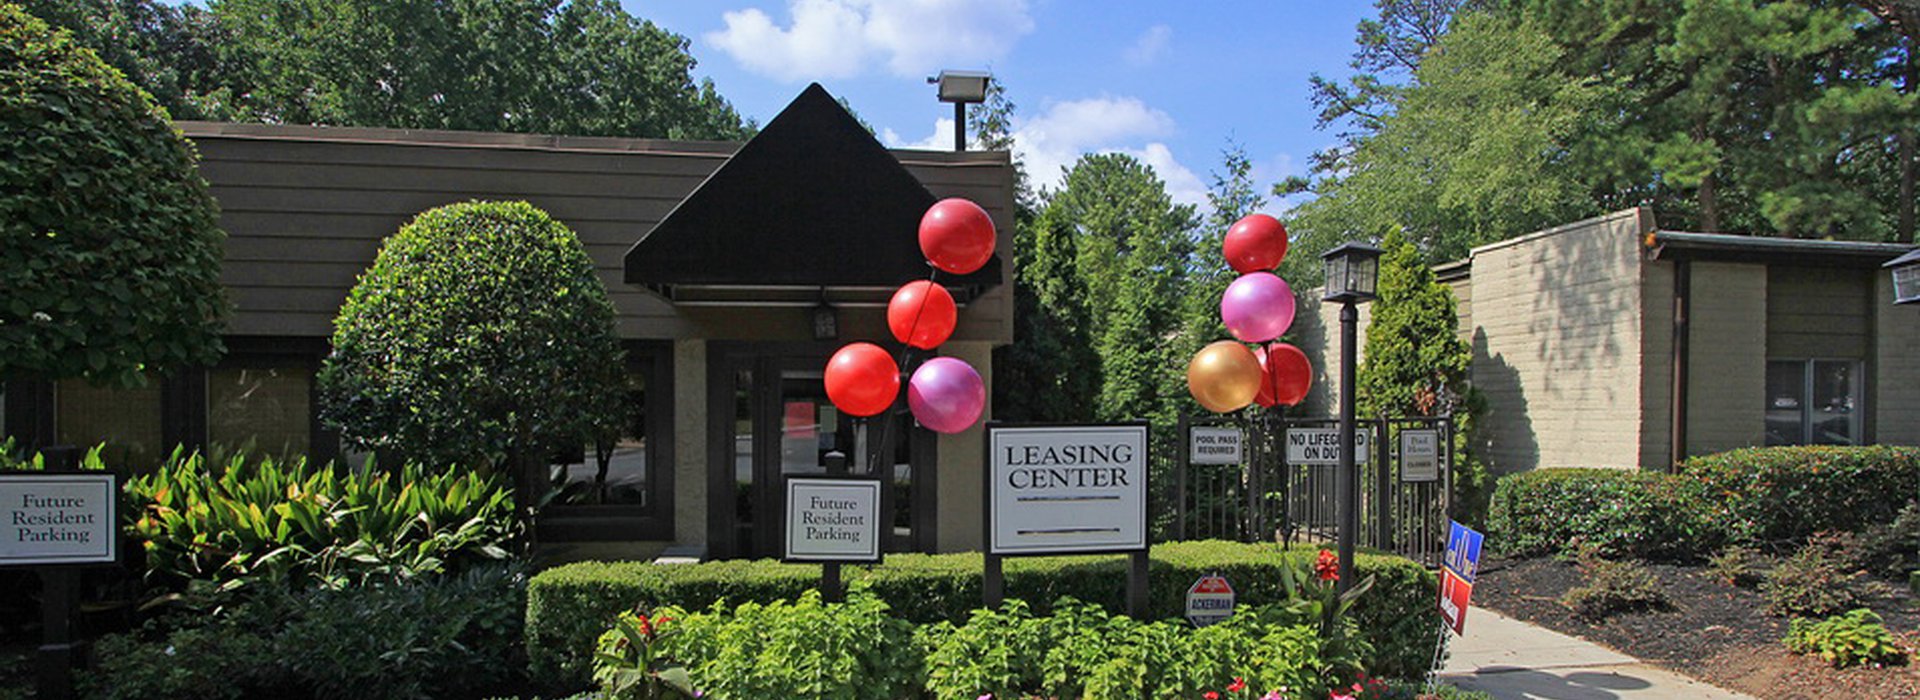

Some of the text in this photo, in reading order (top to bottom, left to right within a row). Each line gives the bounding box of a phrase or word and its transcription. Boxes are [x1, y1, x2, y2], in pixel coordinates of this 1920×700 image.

[1195, 435, 1238, 444] POOL PASS
[1290, 433, 1365, 446] NO LIFEGD
[1005, 444, 1132, 466] LEASING
[1197, 445, 1236, 455] REQUIRED
[1304, 446, 1342, 459] ON DUT
[1008, 467, 1130, 489] CENTER
[23, 494, 85, 508] Future
[810, 496, 857, 510] Future
[12, 510, 95, 526] Resident
[802, 511, 864, 525] Resident
[18, 527, 91, 544] Parking
[806, 526, 860, 543] Parking
[1191, 598, 1231, 610] ACKERMAN
